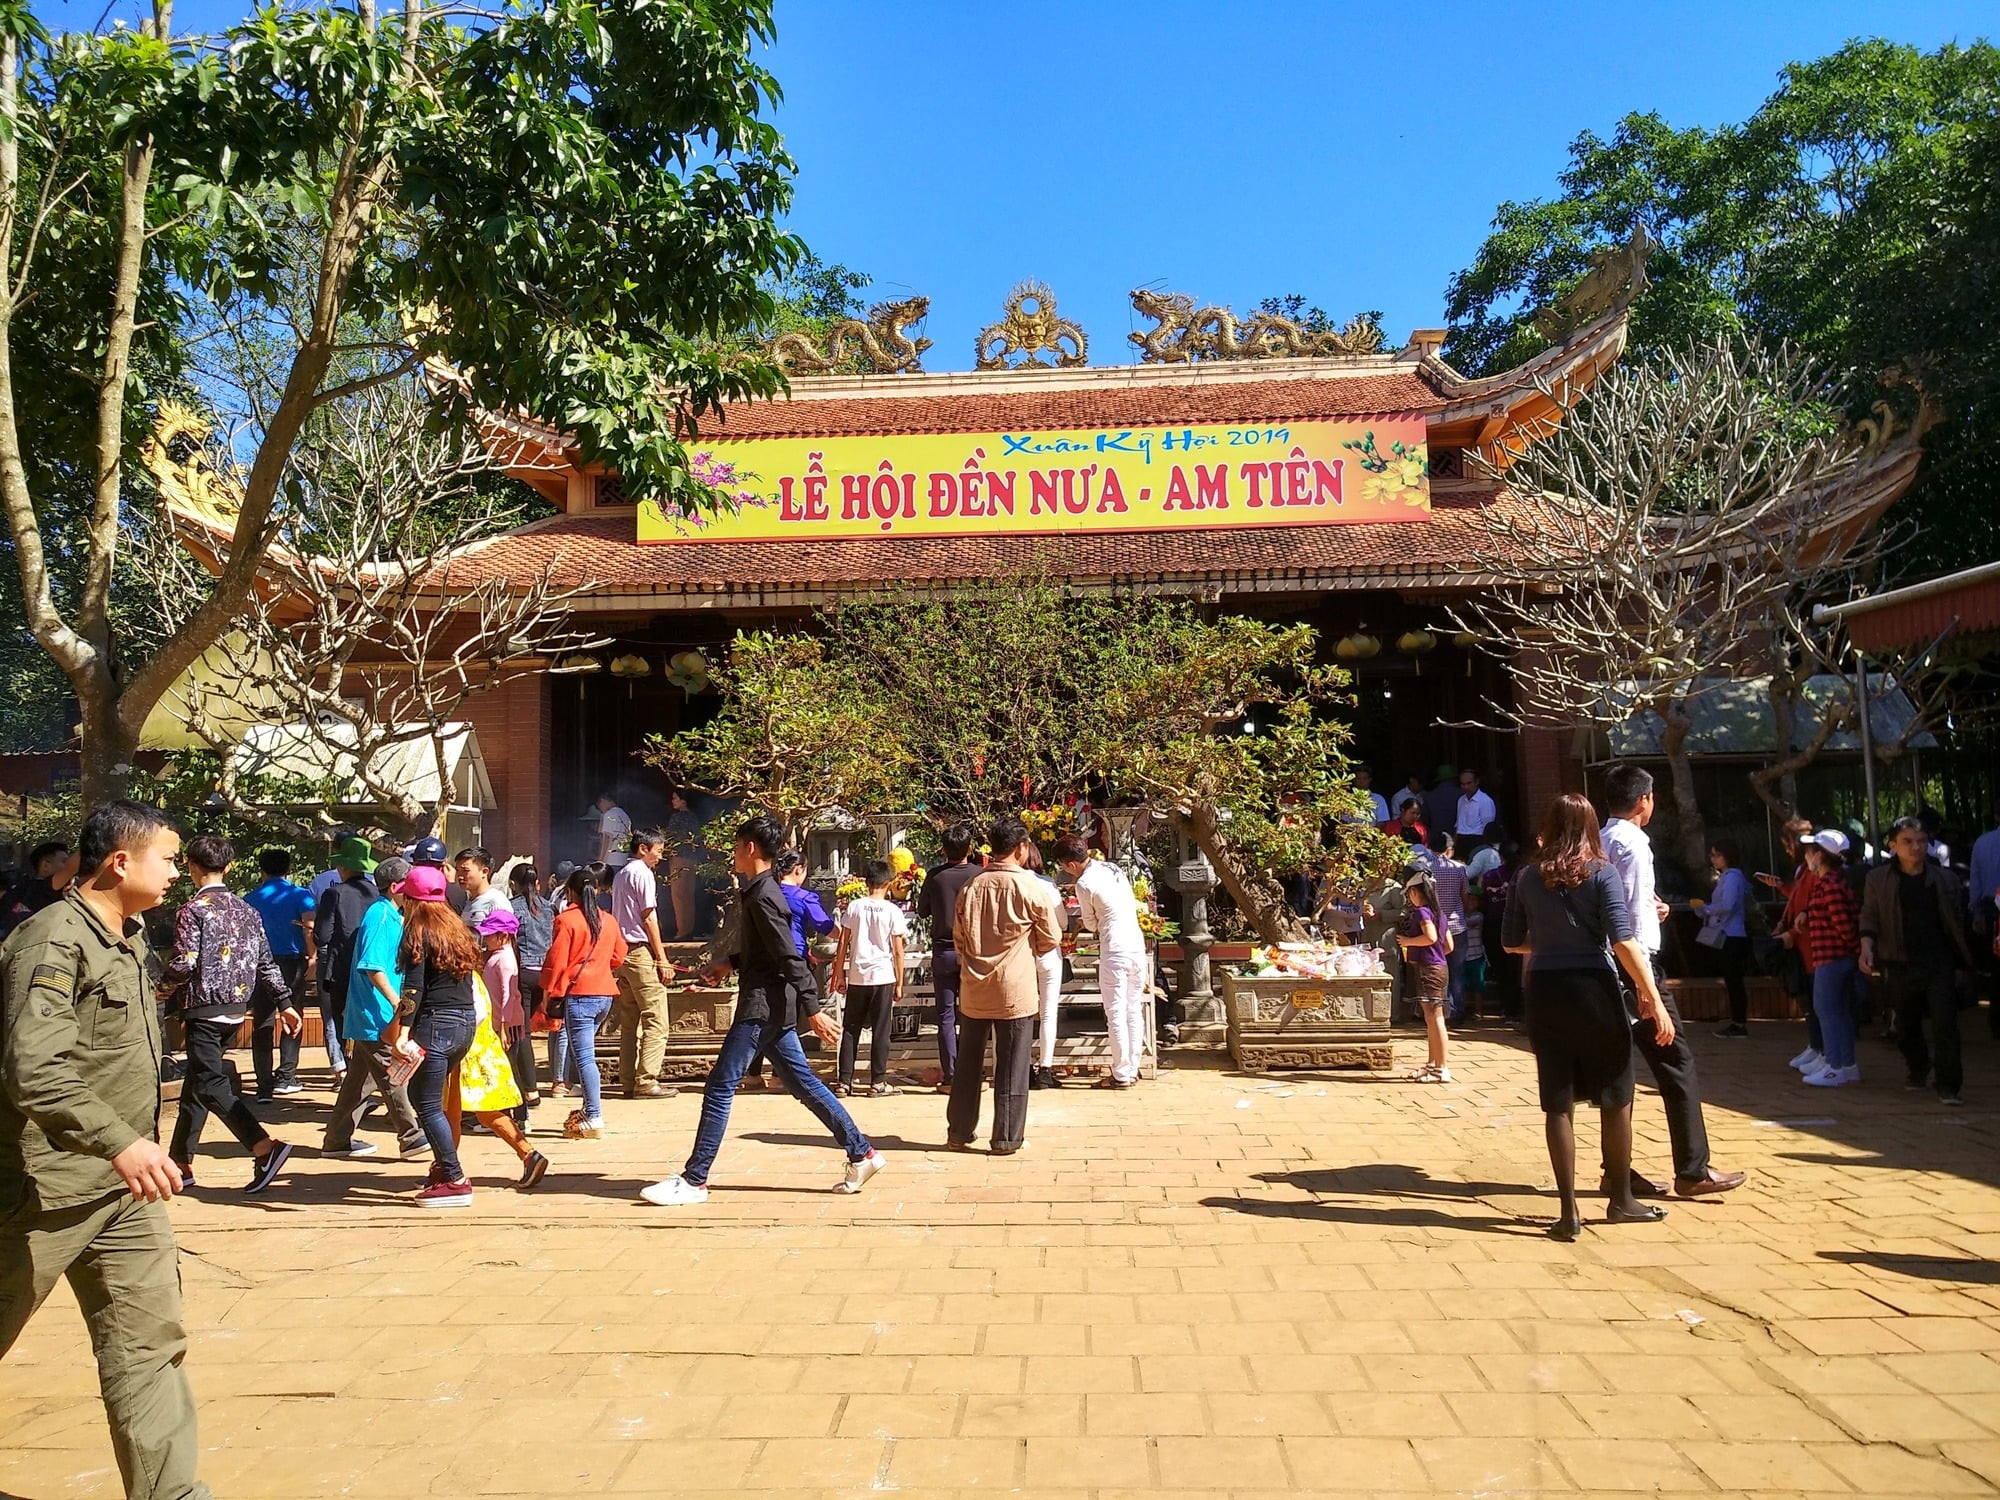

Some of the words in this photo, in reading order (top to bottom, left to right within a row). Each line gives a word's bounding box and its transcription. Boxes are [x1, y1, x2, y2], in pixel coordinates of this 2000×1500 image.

[1002, 435, 1092, 456] Xuân
[1226, 428, 1290, 446] 2019
[778, 451, 831, 522] LỄ
[840, 459, 917, 532] HỘI
[927, 447, 1017, 518] ĐỀN
[1027, 462, 1130, 516] NƯA
[1162, 463, 1230, 512] AM
[1239, 446, 1345, 509] TIÊN
